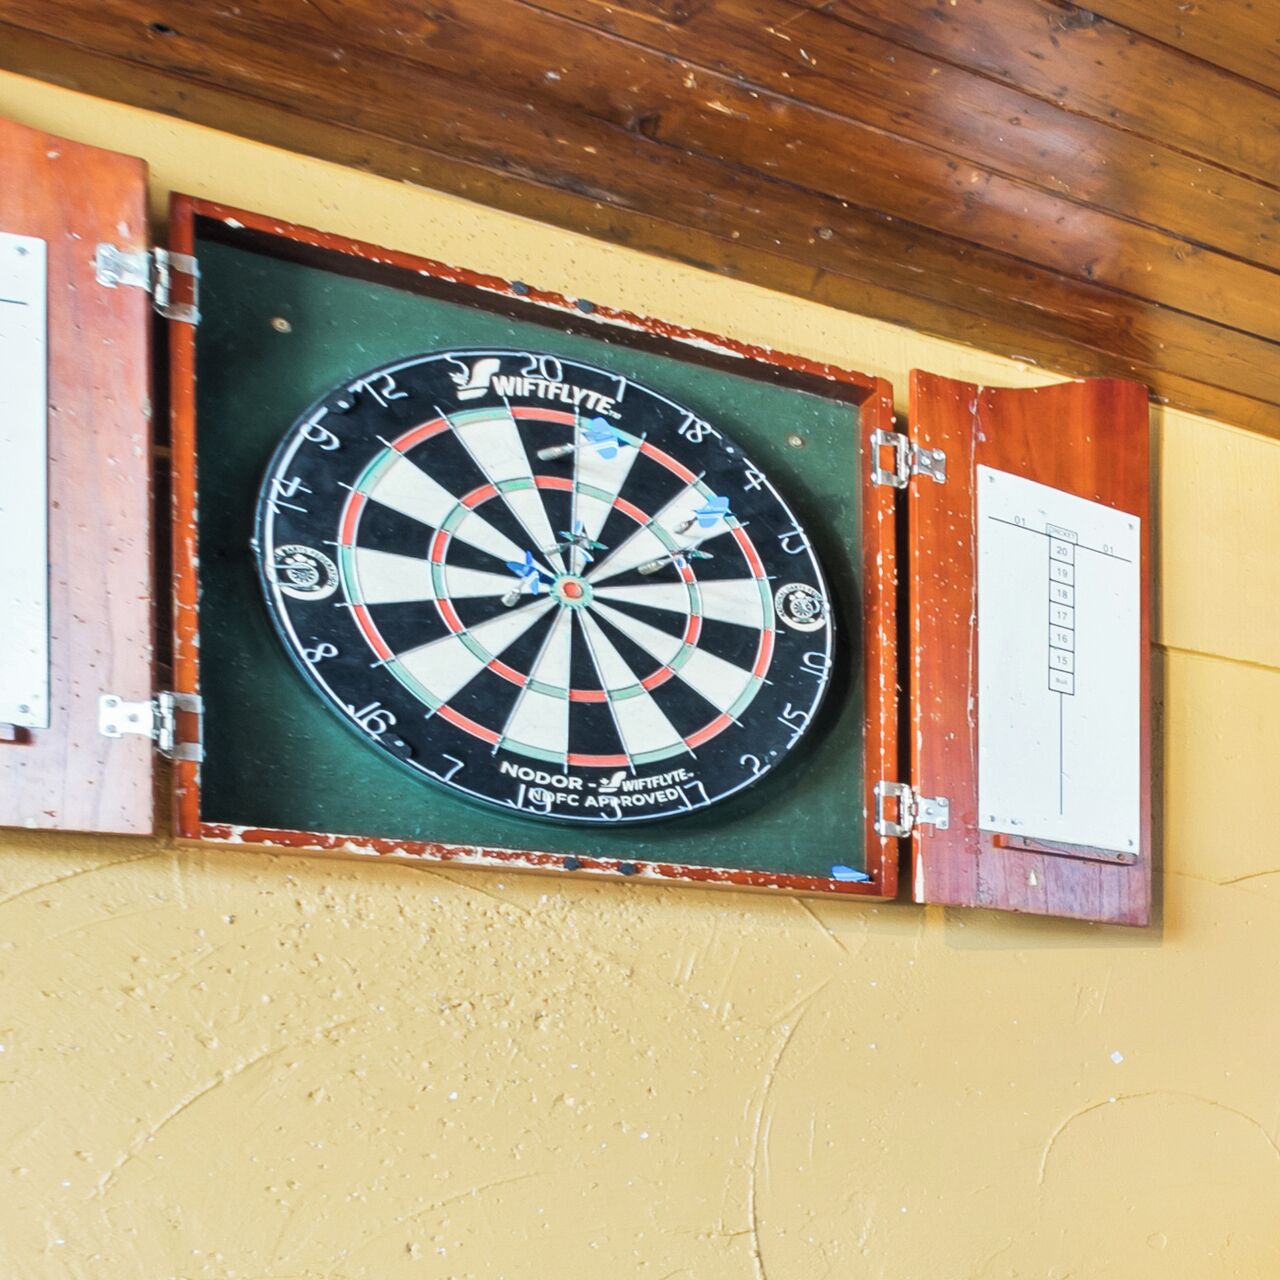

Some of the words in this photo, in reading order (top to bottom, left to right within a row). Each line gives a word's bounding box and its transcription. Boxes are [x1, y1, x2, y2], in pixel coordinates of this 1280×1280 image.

[520, 353, 563, 382] 20
[352, 374, 408, 408] 12
[300, 423, 340, 450] 9
[680, 410, 711, 443] 18
[267, 476, 312, 514] 14
[744, 469, 767, 493] 4
[1056, 545, 1068, 557] 20
[1056, 567, 1068, 578] 19
[1056, 589, 1068, 600] 18
[1056, 610, 1068, 621] 17
[1056, 632, 1068, 643] 16
[301, 642, 339, 663] 8
[1056, 655, 1068, 666] 15
[799, 651, 832, 684] 10
[347, 701, 397, 735] 16
[777, 702, 811, 738] 15
[442, 753, 465, 783] 7
[500, 760, 583, 791] NODOR
[740, 753, 762, 776] 2
[507, 784, 552, 815] 19
[584, 787, 680, 808] APPROVED
[678, 781, 711, 811] 17
